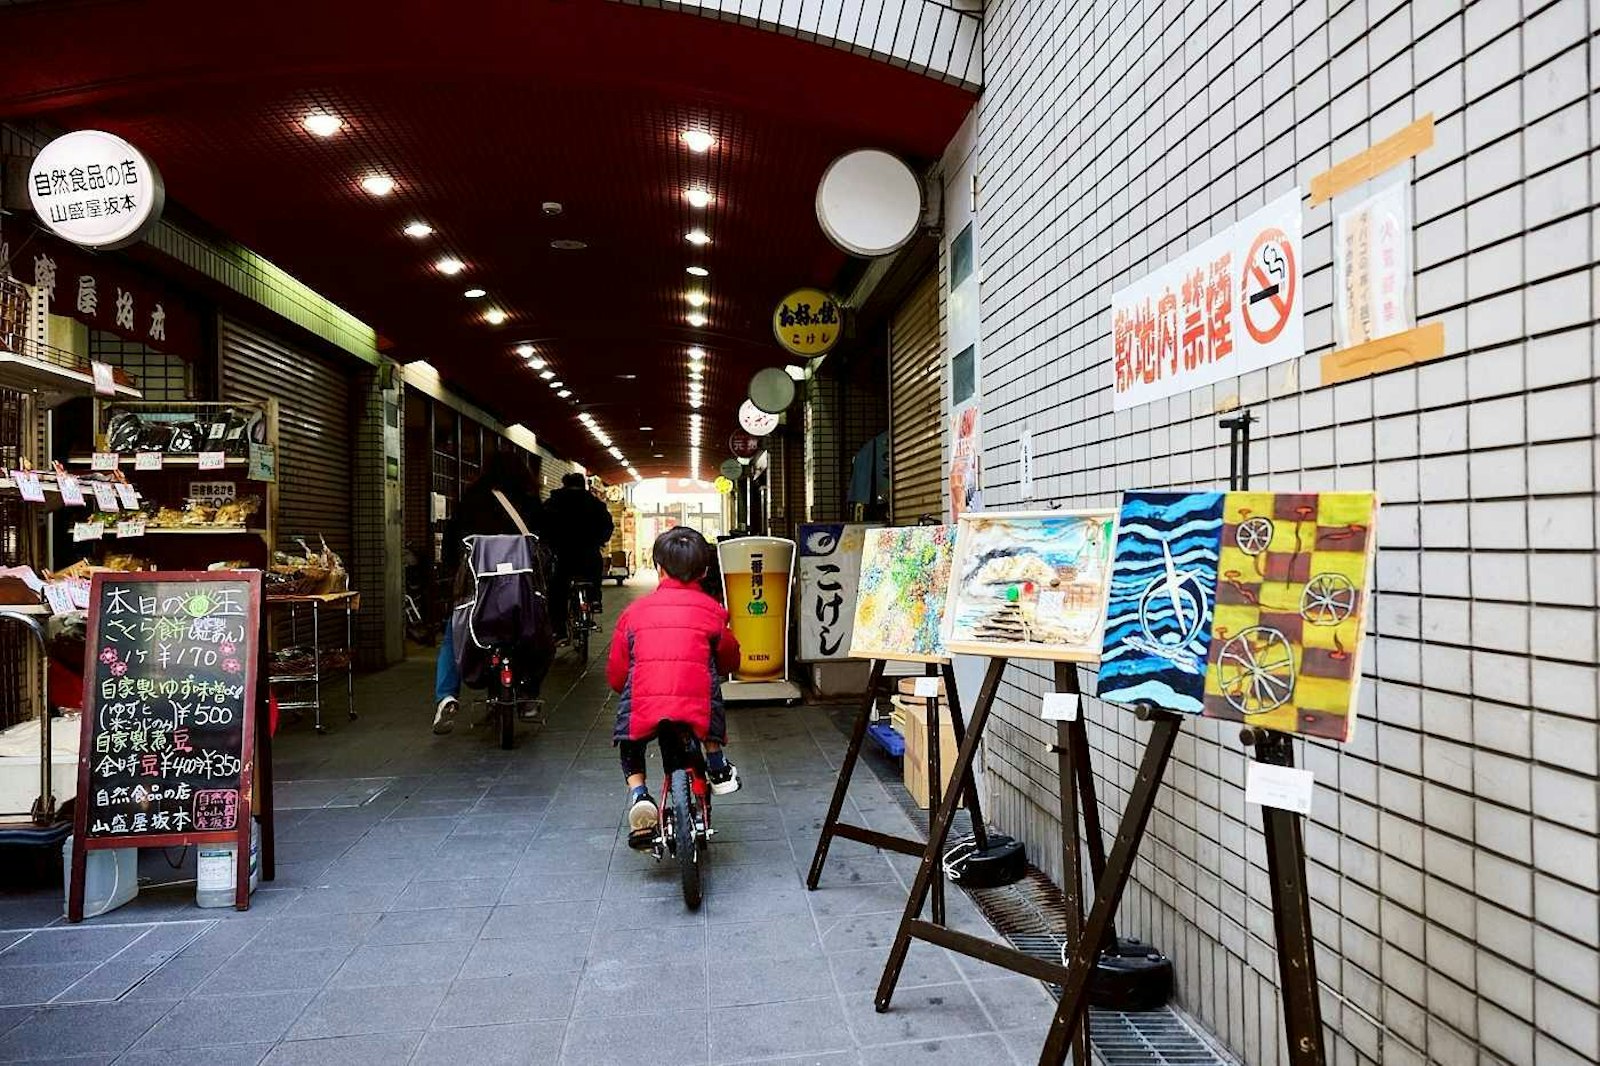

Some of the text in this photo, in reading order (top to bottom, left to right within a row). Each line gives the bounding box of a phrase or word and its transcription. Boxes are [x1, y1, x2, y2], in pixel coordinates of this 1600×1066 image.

[34, 160, 137, 196] 自然食品の店
[50, 194, 136, 222] 山盛屋坂本
[780, 300, 838, 327] お好み焼
[1115, 251, 1232, 393] 敷地内禁煙
[792, 332, 829, 344] こけし
[751, 553, 763, 600] 一番搾り
[815, 564, 844, 656] こけし
[96, 782, 192, 806] 自然食品の店
[92, 806, 192, 832] 山盛屋坂本
